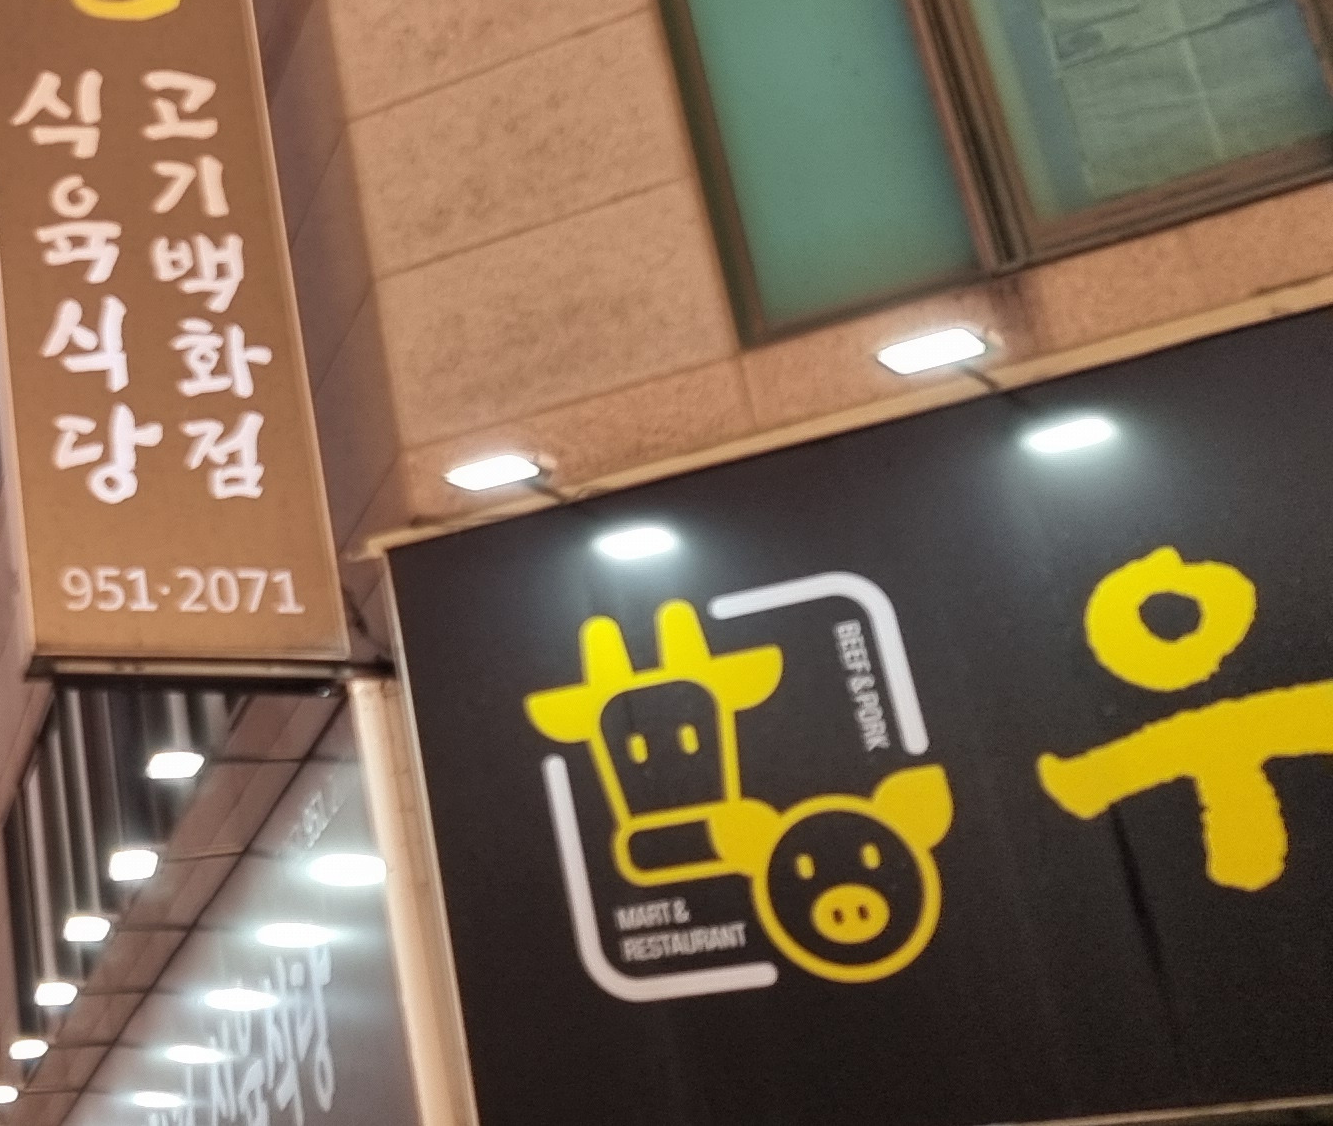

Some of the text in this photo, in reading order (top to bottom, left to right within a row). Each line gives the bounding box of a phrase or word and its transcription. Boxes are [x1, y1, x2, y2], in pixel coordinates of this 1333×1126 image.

[10, 69, 164, 505] 식육식당
[141, 69, 273, 501] 고기백화점
[615, 901, 672, 931] MART
[621, 921, 746, 962] RESTAURANT
